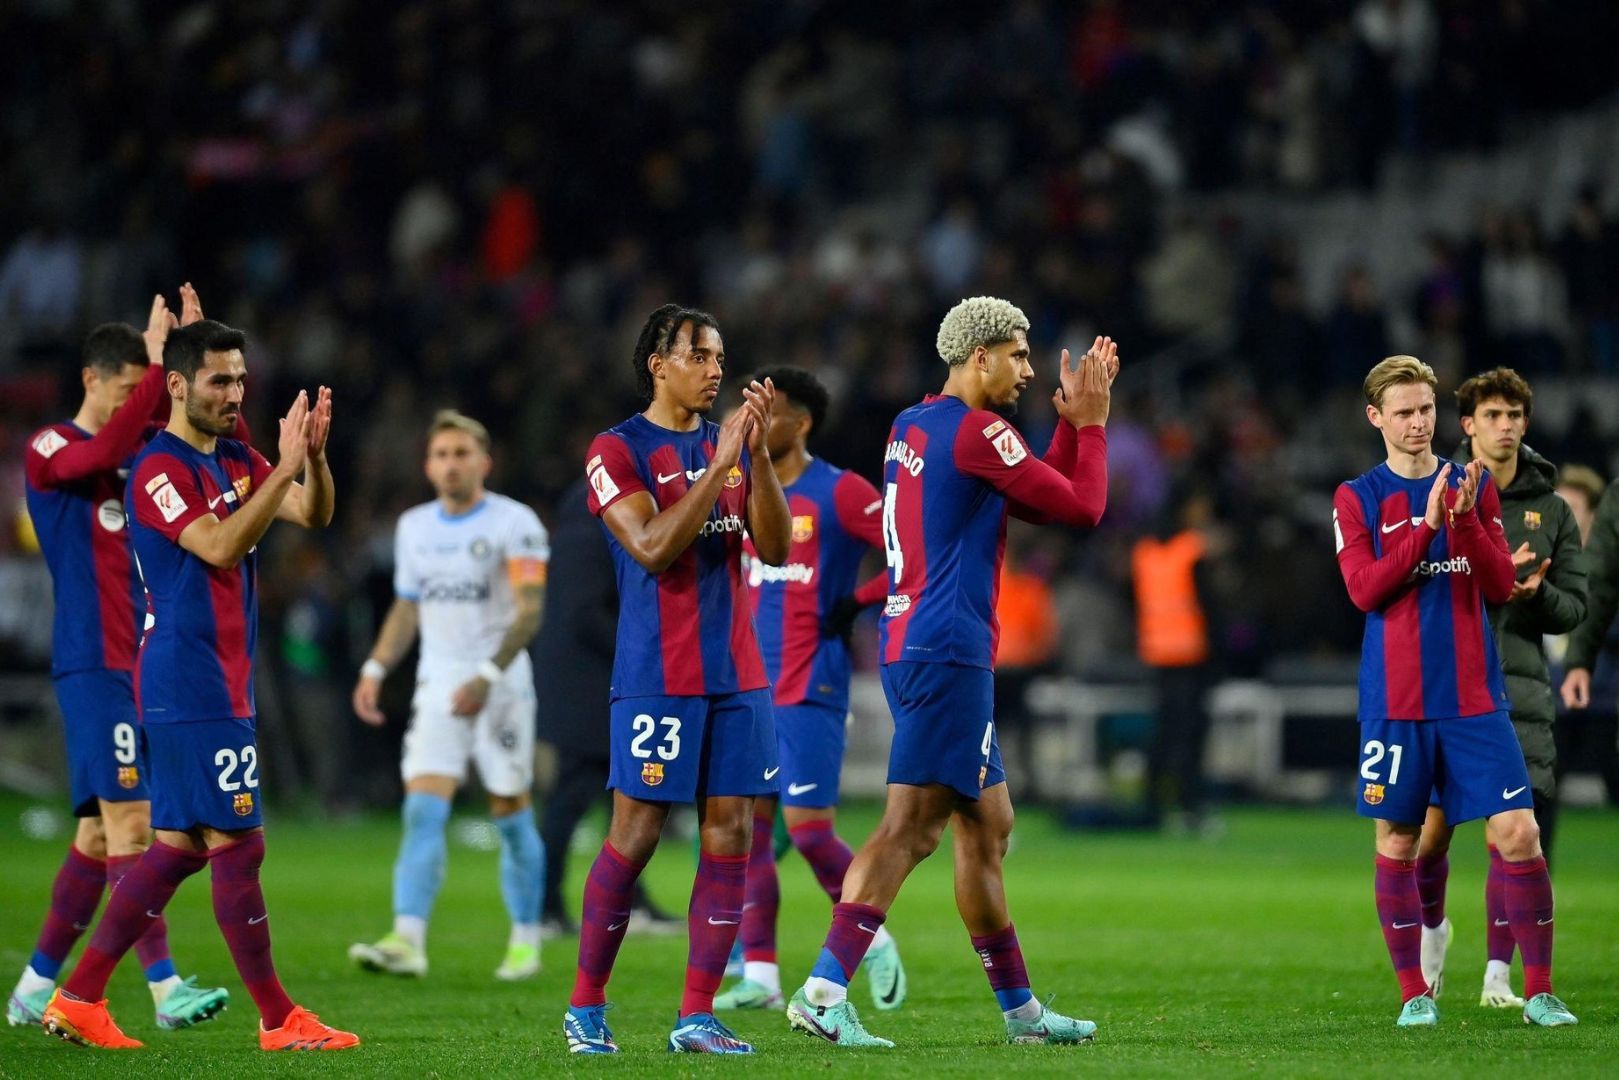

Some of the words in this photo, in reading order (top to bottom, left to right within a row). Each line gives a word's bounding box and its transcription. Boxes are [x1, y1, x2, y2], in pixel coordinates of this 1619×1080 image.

[882, 482, 905, 585] 4
[1420, 556, 1472, 577] Spotify
[114, 722, 136, 764] 9
[630, 713, 682, 761] 23
[981, 721, 993, 764] 4
[214, 745, 259, 792] 22
[1360, 739, 1403, 785] 21
